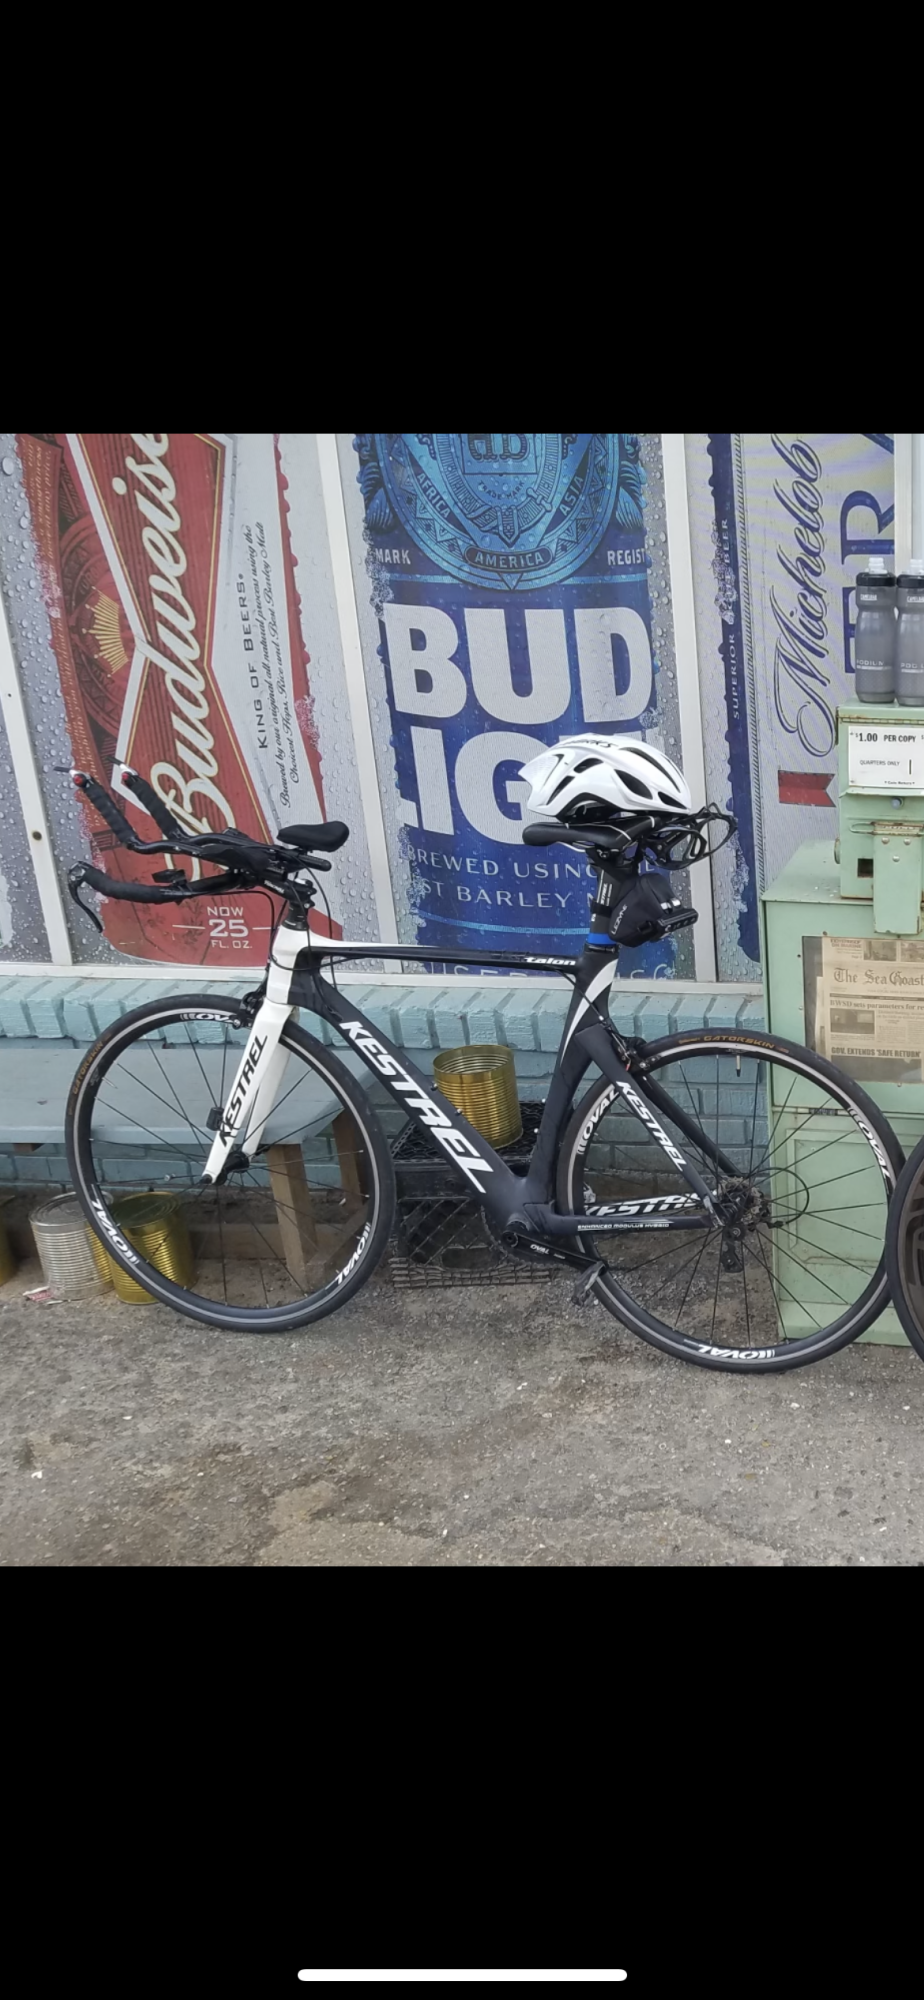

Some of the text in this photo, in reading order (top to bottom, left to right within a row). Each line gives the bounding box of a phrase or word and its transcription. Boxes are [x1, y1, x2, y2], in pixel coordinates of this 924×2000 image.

[416, 472, 451, 519] AFRICA
[559, 474, 584, 516] ASIA
[255, 521, 267, 559] Malt
[375, 549, 411, 565] MARK
[722, 518, 731, 564] BEER
[474, 553, 545, 568] AMERICA
[261, 560, 275, 607] Barley
[268, 608, 279, 640] Best
[243, 525, 291, 808] Brewed by our original all natural process using the
[271, 641, 282, 666] and
[383, 602, 652, 724] BUD
[248, 662, 259, 689] OF
[276, 667, 287, 698] Rice
[729, 634, 740, 719] SUPERIOR
[254, 699, 268, 748] KING
[898, 735, 916, 743] COPY
[287, 737, 299, 784] Choicest
[207, 907, 244, 916] NOW
[457, 886, 568, 909] BARLEY
[209, 919, 249, 937] 25
[211, 941, 252, 949] FL. OZ.
[524, 956, 576, 966] talon
[833, 967, 858, 984] The
[862, 969, 888, 985] Sea
[704, 1036, 775, 1049] GATORSKIN
[831, 1046, 846, 1054] GOV.
[847, 1048, 875, 1056] EXTENDS
[218, 1035, 268, 1147] KESTREL
[339, 1021, 494, 1194] KESTREL
[583, 1089, 620, 1140] OVAL
[616, 1081, 687, 1171] KESTREL
[859, 1122, 891, 1178] OVAL
[92, 1198, 128, 1252] OVAL
[337, 1236, 366, 1285] OVAL
[530, 1243, 550, 1255] OVAL
[698, 1344, 759, 1359] OVAL
